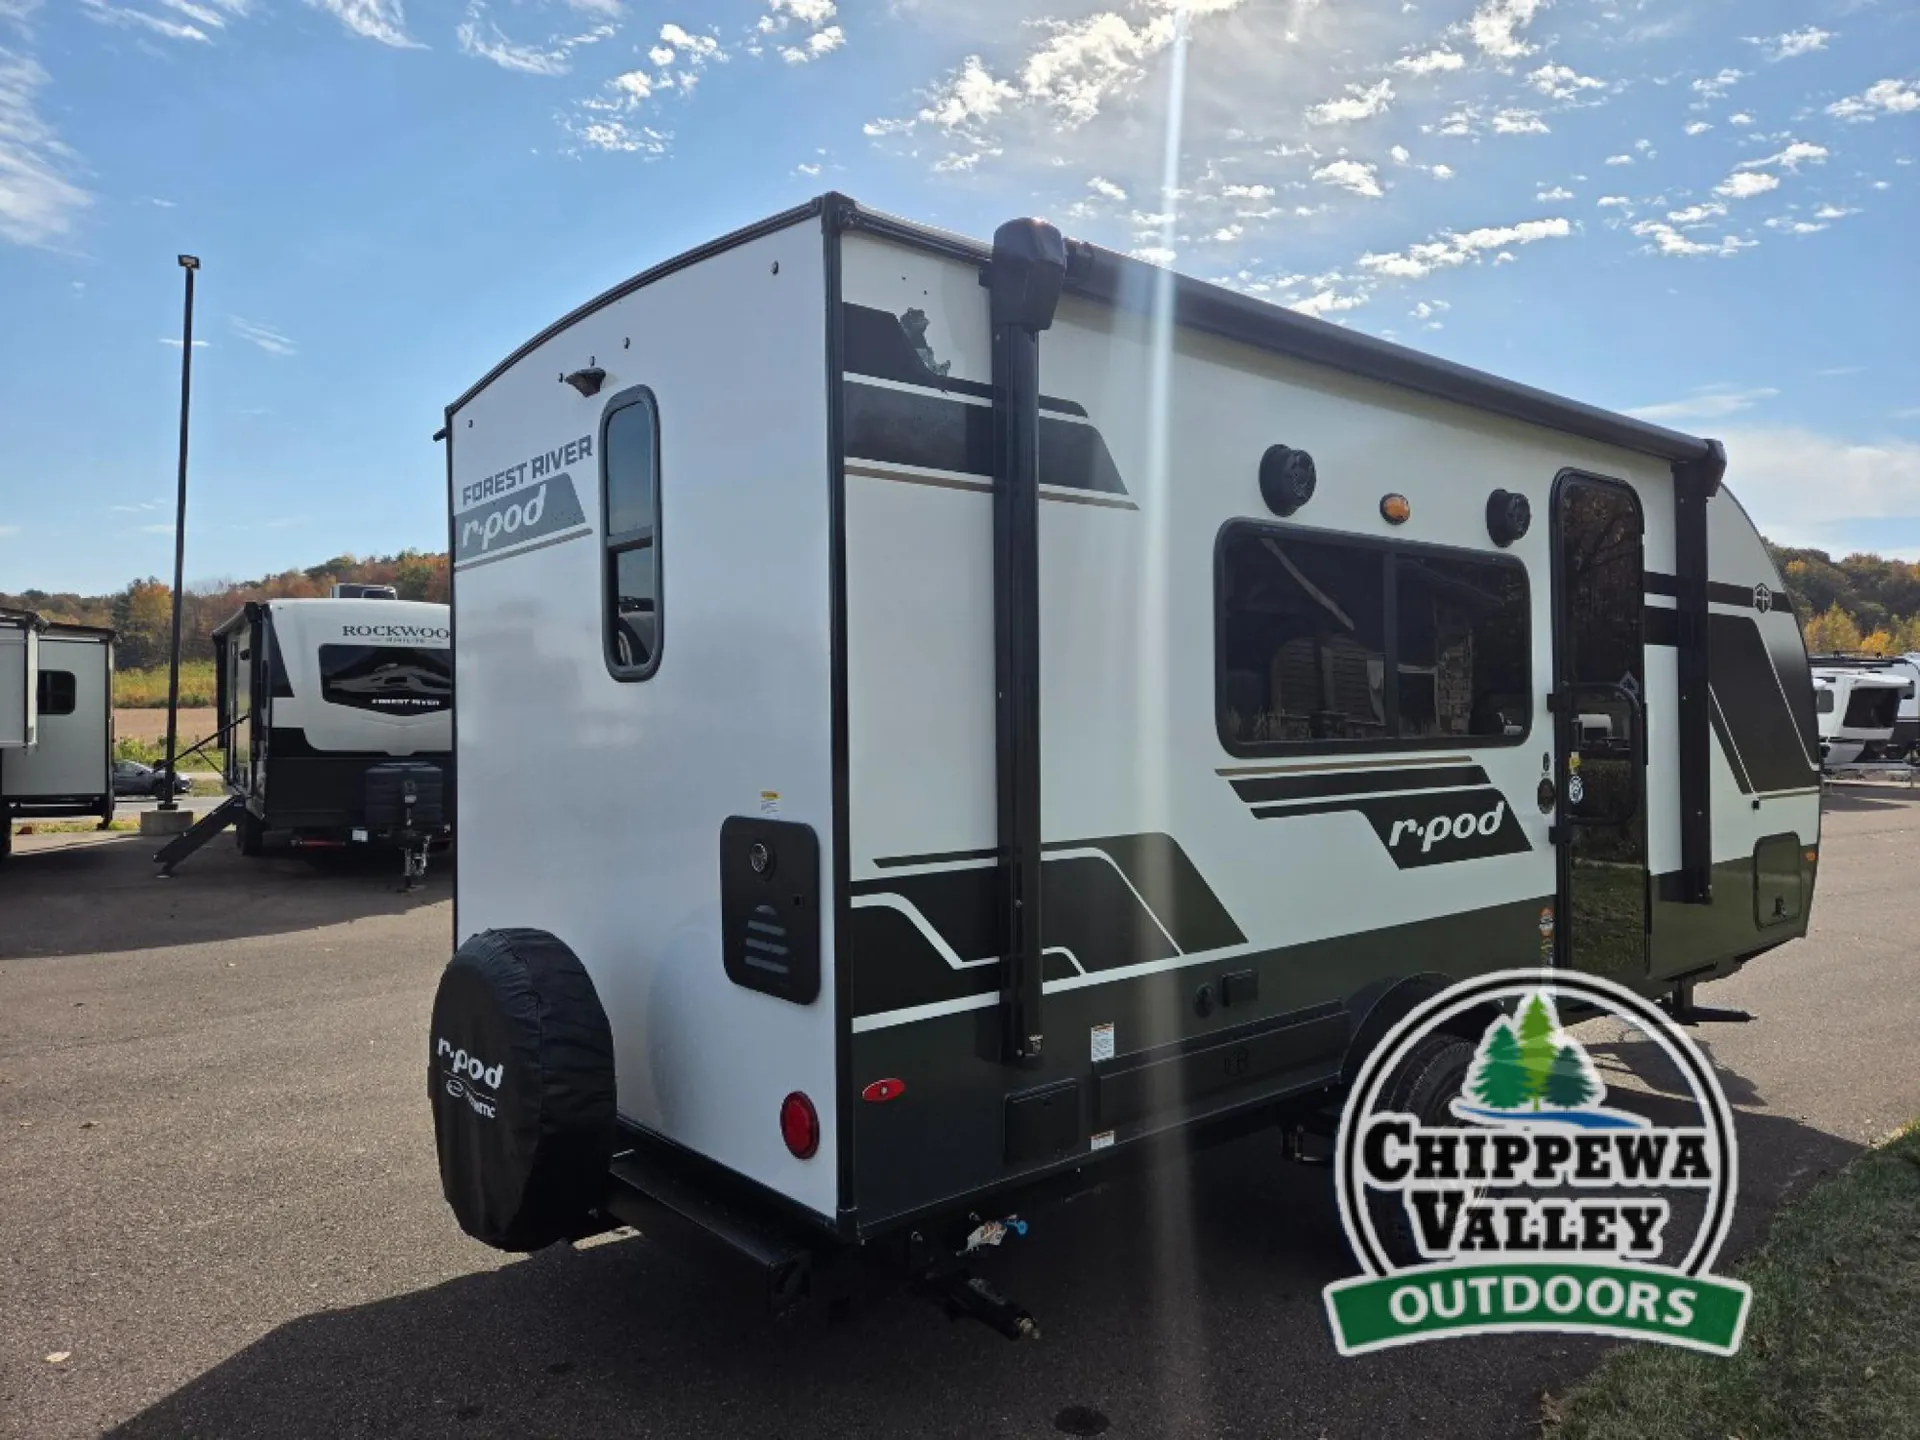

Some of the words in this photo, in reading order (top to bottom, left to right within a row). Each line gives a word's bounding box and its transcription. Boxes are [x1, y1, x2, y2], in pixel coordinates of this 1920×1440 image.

[463, 462, 527, 506] FOREST
[532, 435, 593, 478] RIVER
[342, 625, 450, 639] ROCKWOO
